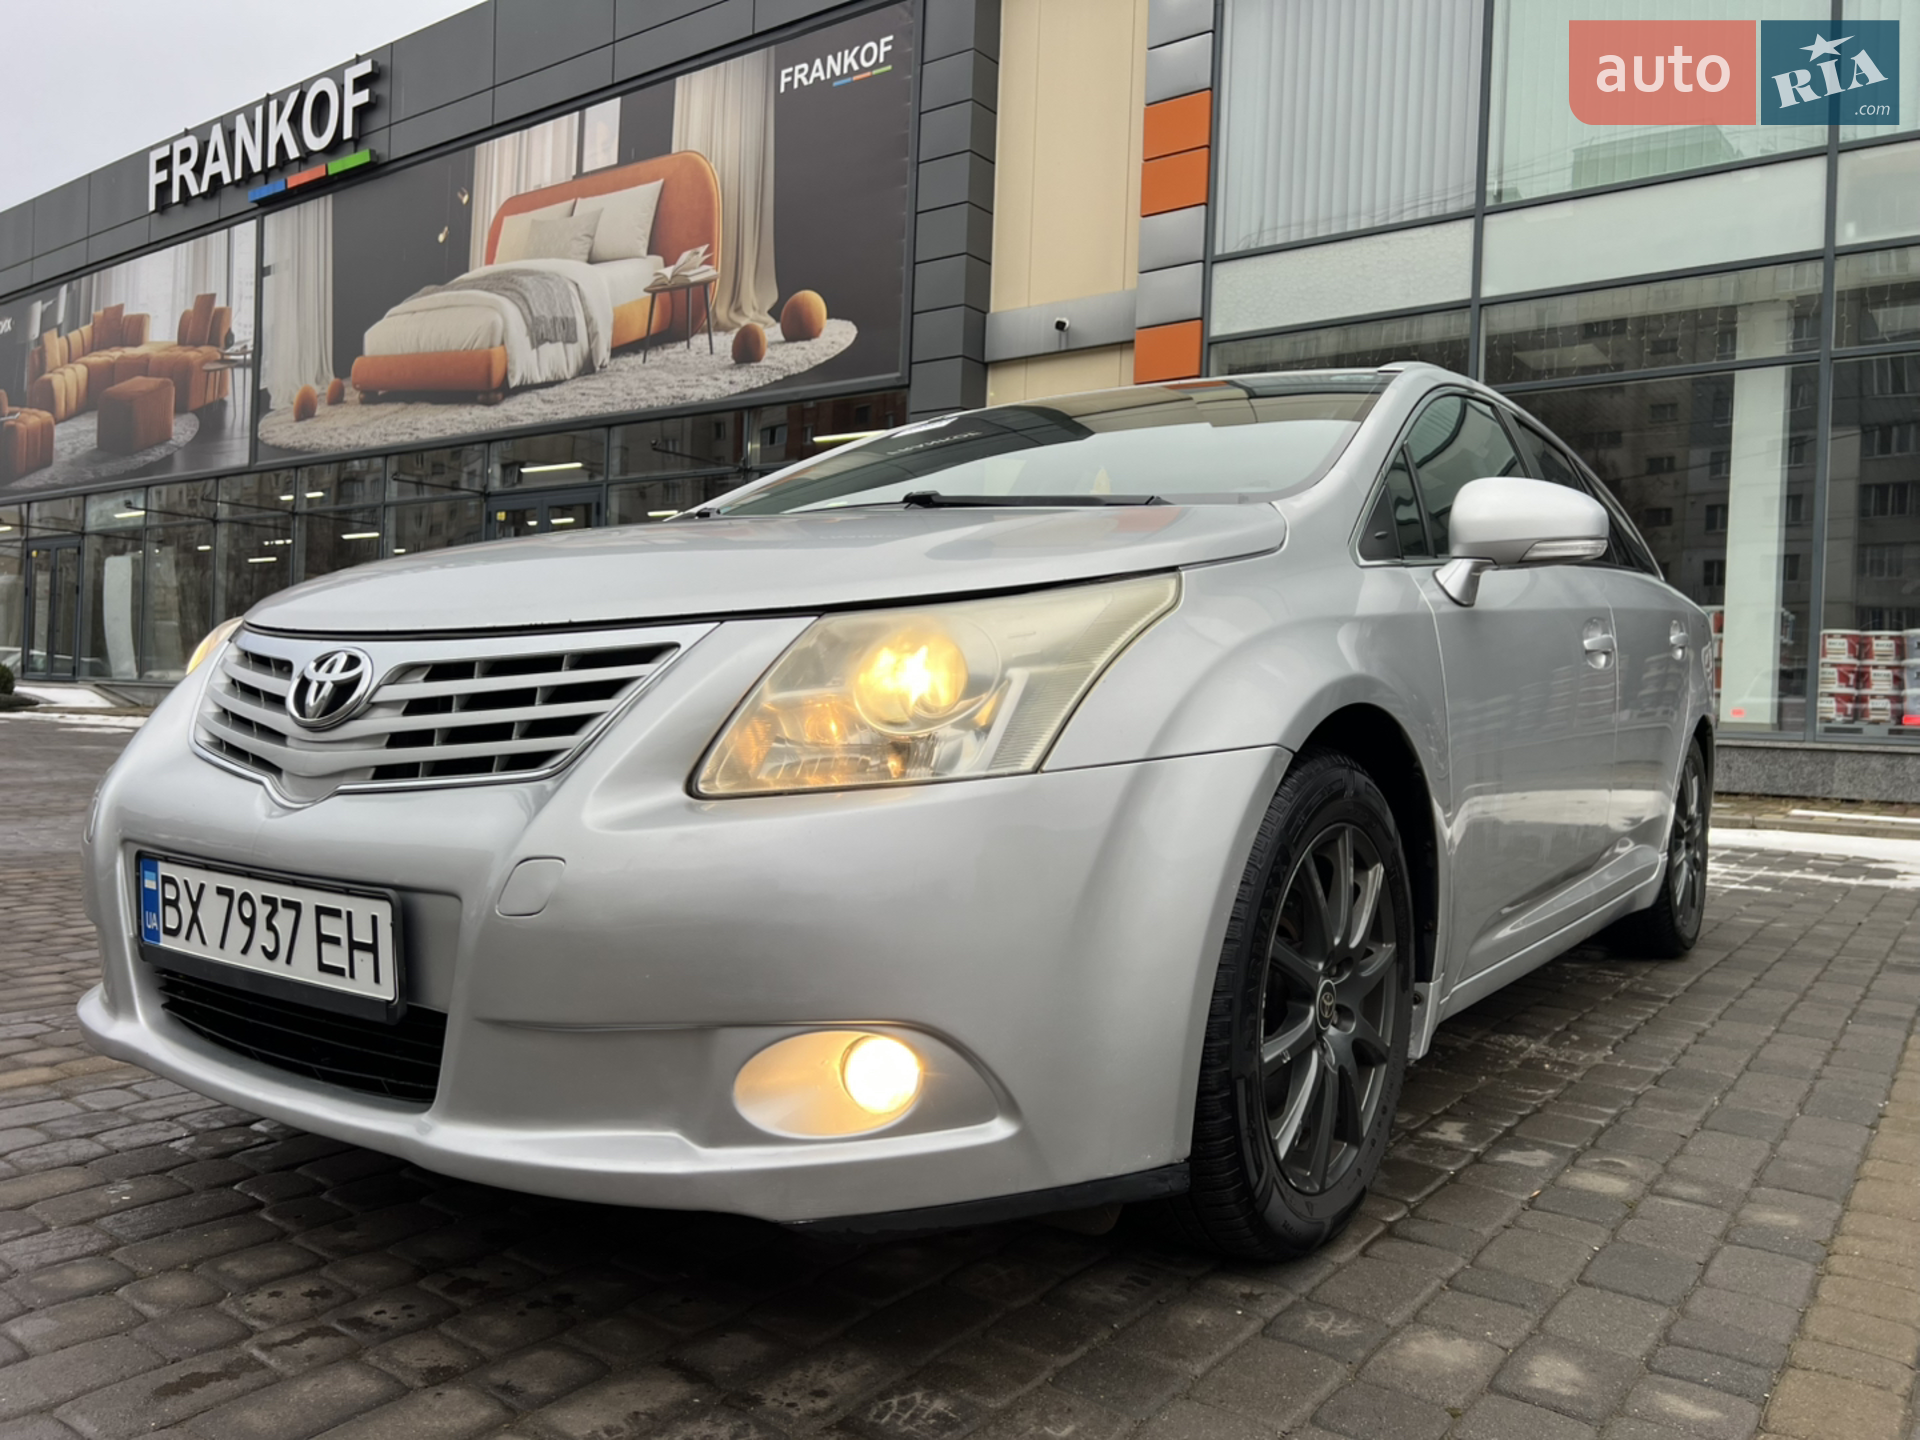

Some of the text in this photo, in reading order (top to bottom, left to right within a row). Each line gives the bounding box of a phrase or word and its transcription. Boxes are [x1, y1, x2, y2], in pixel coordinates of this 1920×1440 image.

[780, 35, 894, 94] FRANKOF
[148, 58, 374, 212] FRANKOF
[145, 909, 159, 931] UA
[160, 873, 381, 985] BX 7937 EH
